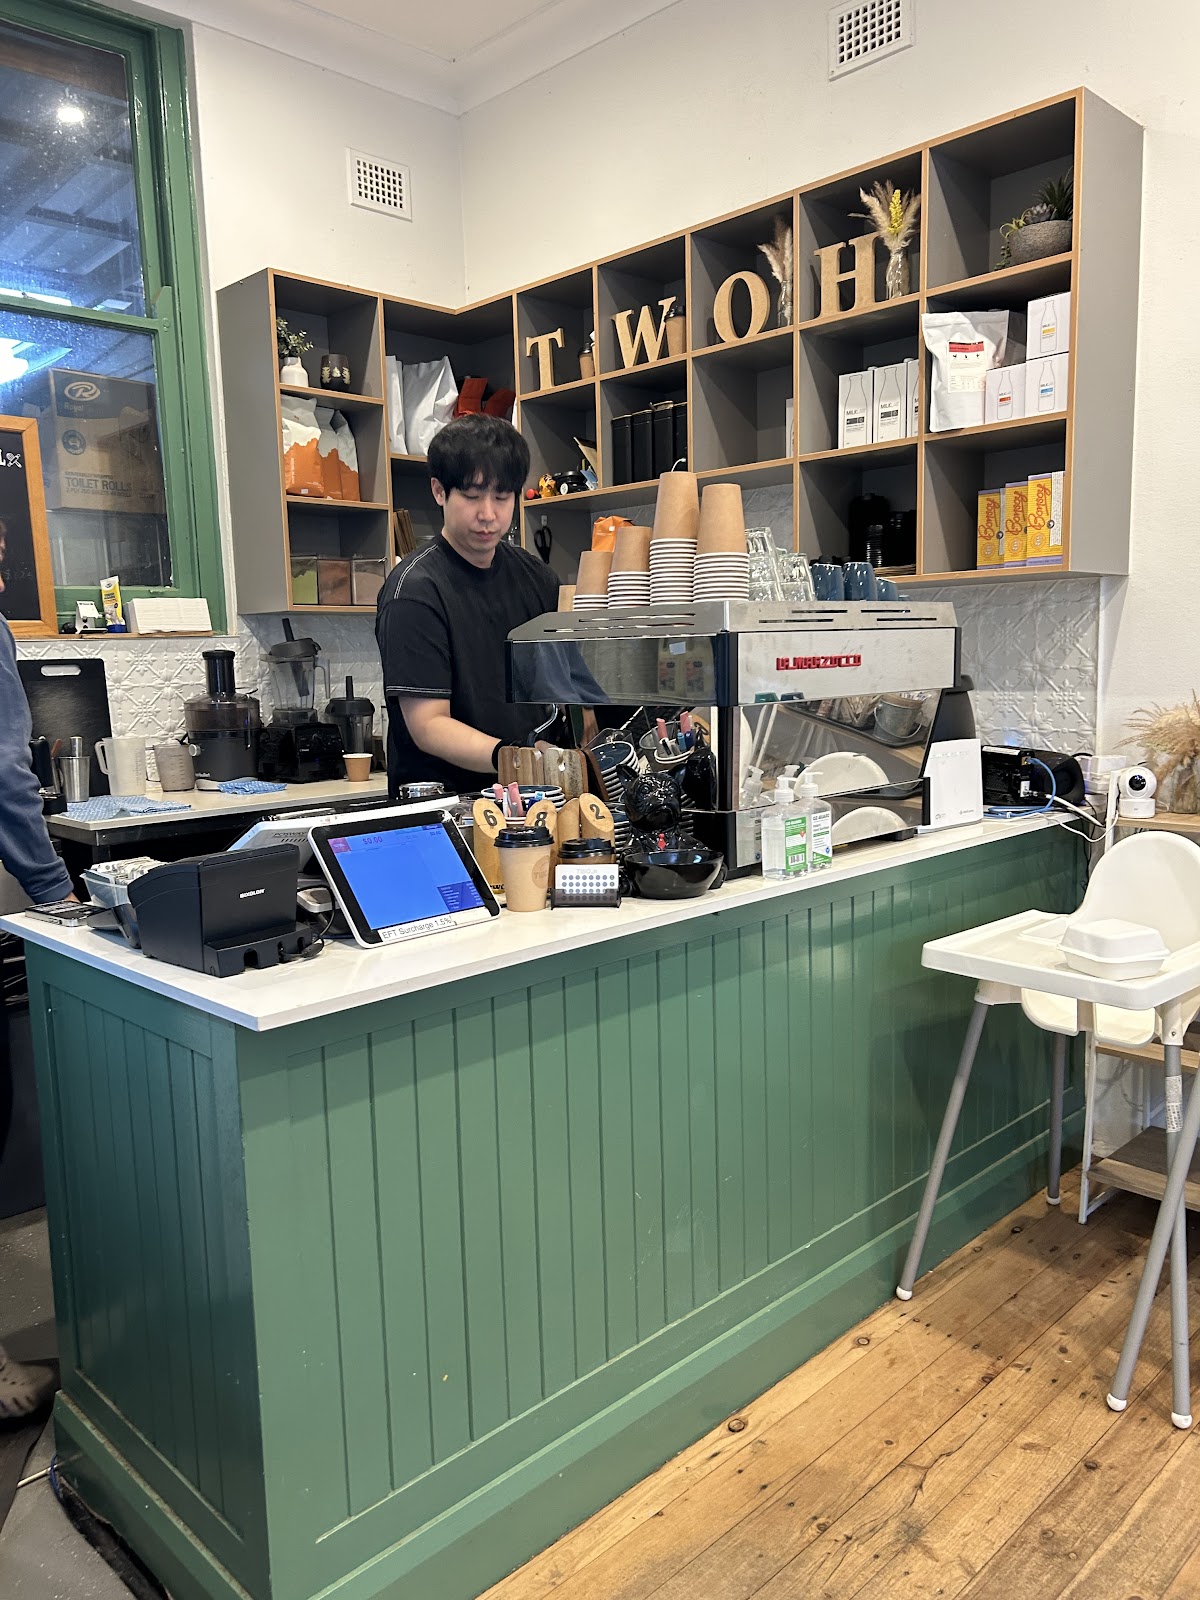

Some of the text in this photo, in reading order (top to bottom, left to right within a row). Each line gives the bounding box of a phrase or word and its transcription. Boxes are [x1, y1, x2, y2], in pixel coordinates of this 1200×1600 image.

[65, 477, 132, 492] TOILET ROLLS
[1005, 490, 1028, 535] Bonsoy
[1027, 484, 1051, 530] Bonsoy
[978, 498, 1000, 540] Bonsoy
[483, 809, 498, 827] 6
[534, 811, 548, 827] 8
[589, 803, 605, 820] 2
[382, 917, 452, 939] EFT Surcharge 1.5%
